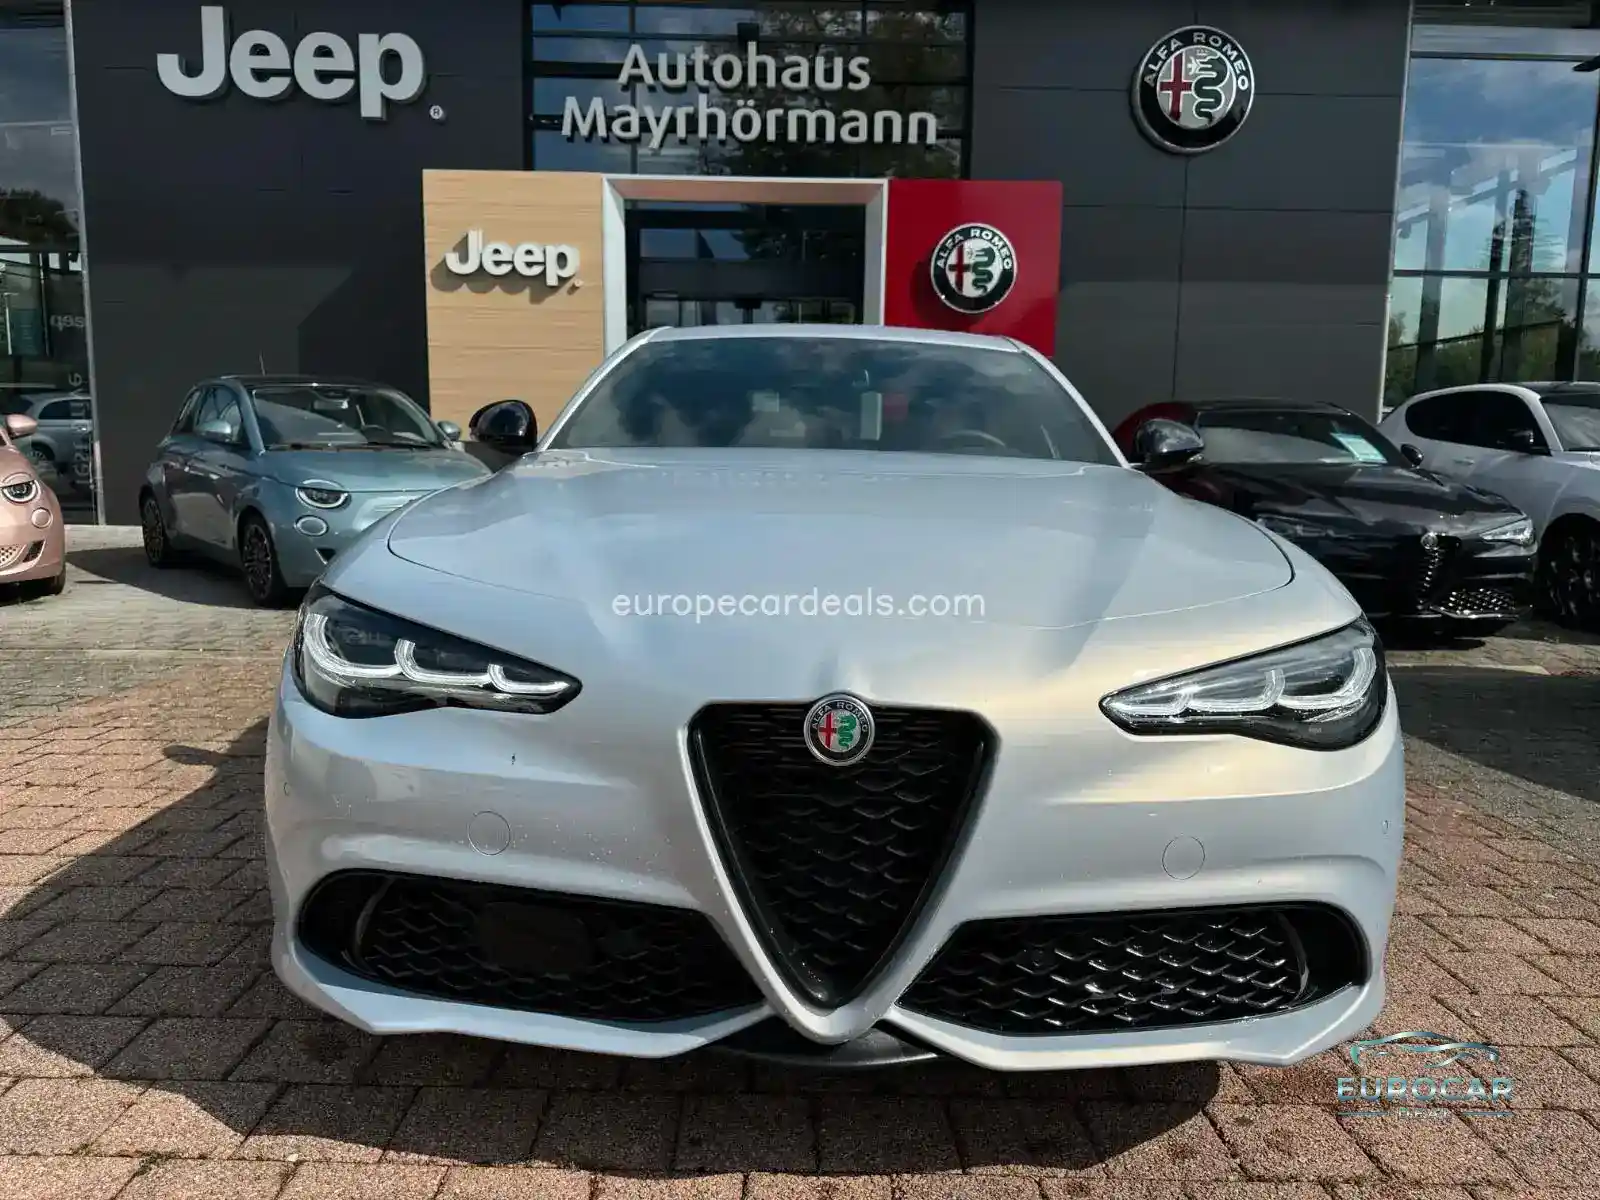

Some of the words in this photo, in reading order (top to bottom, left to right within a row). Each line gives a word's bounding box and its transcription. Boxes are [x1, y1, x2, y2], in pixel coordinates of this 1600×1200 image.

[157, 6, 424, 118] Jeep
[618, 41, 871, 91] Autohaus
[1143, 37, 1184, 88] ALFA
[1192, 32, 1250, 91] ROMEO
[561, 93, 937, 149] Mayrhörmann
[445, 228, 581, 287] Jeep
[937, 234, 964, 269] ALFA
[970, 228, 1012, 270] ROMEO
[812, 705, 832, 730] ALFA
